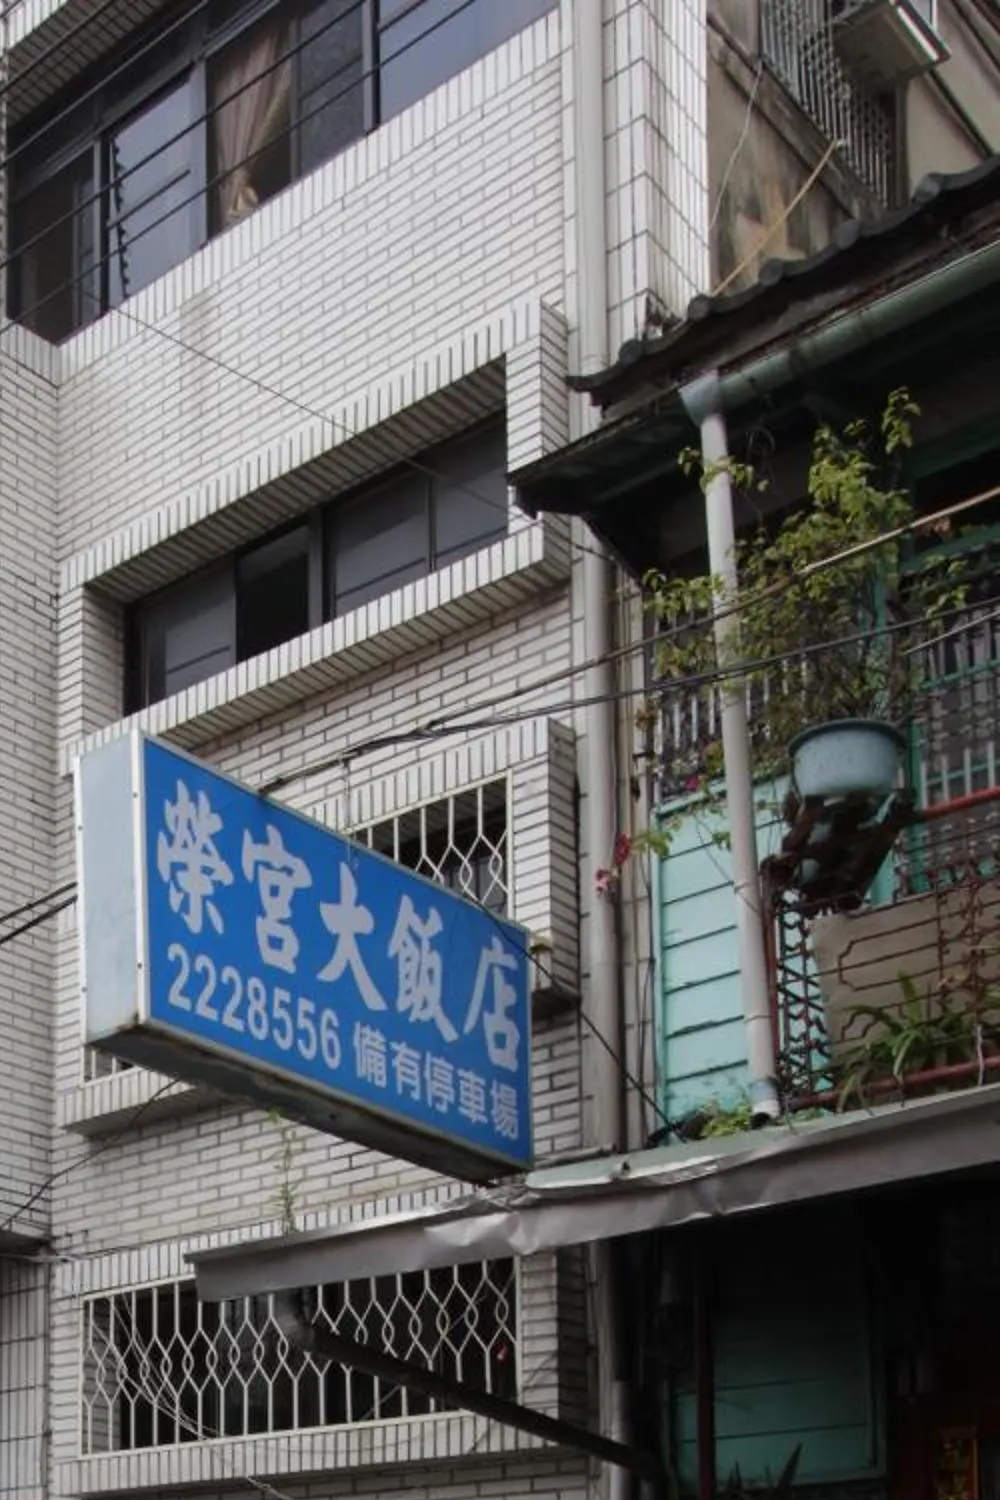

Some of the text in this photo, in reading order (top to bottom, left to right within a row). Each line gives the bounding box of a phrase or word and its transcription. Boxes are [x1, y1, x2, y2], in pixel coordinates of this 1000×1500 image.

[156, 778, 520, 1074] 榮宮大飯店
[166, 943, 519, 1140] 2228556 備有停車場
